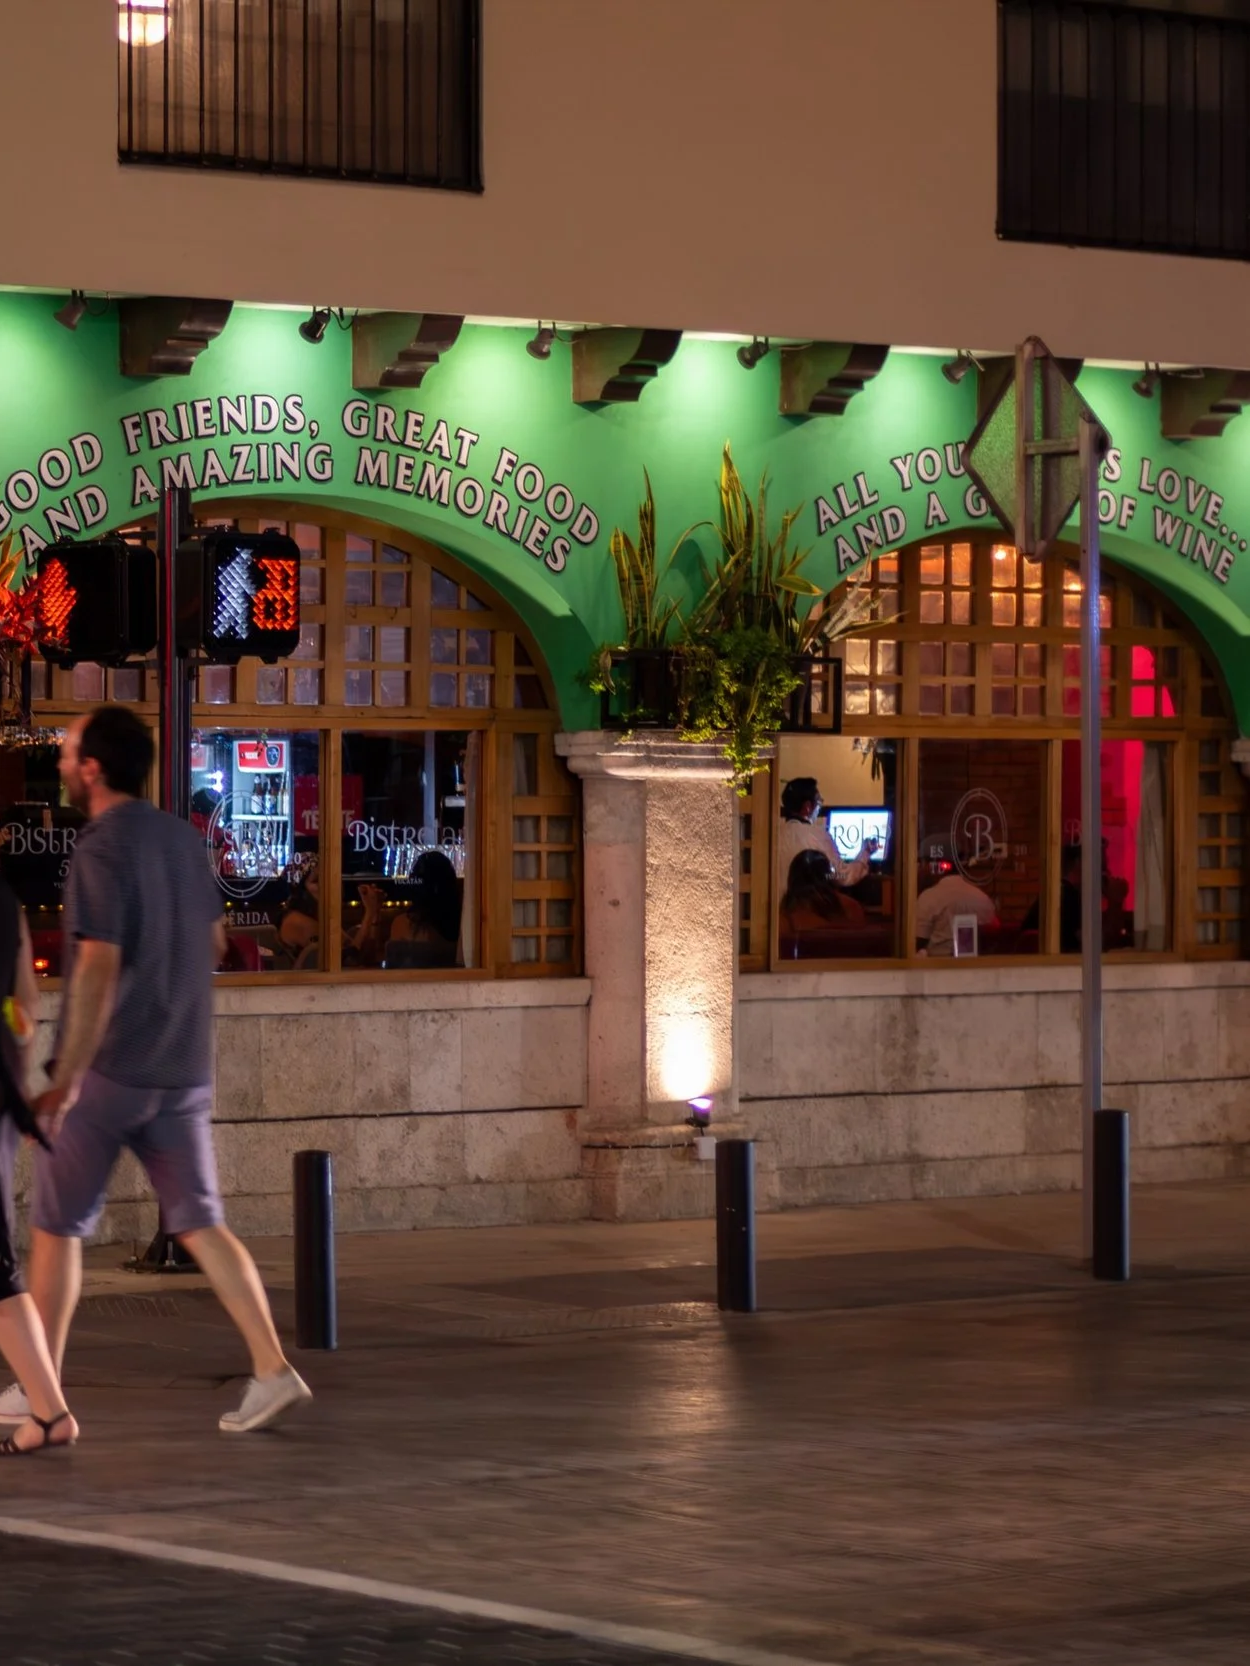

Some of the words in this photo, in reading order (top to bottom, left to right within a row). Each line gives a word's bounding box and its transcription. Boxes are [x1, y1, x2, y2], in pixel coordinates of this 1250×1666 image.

[20, 484, 109, 569] AND
[132, 442, 334, 507] AMAZING
[354, 446, 571, 575] MEMORIES
[121, 394, 320, 456] FRIENDS,
[342, 398, 480, 468] GREAT
[491, 446, 600, 546] FOOD
[814, 471, 879, 536] ALL
[891, 441, 968, 490] YOU
[833, 505, 907, 573] AND
[925, 491, 949, 529] A
[1098, 489, 1137, 529] OF
[1153, 505, 1236, 584] WINE
[58, 859, 71, 877] 5
[964, 813, 995, 862] B
